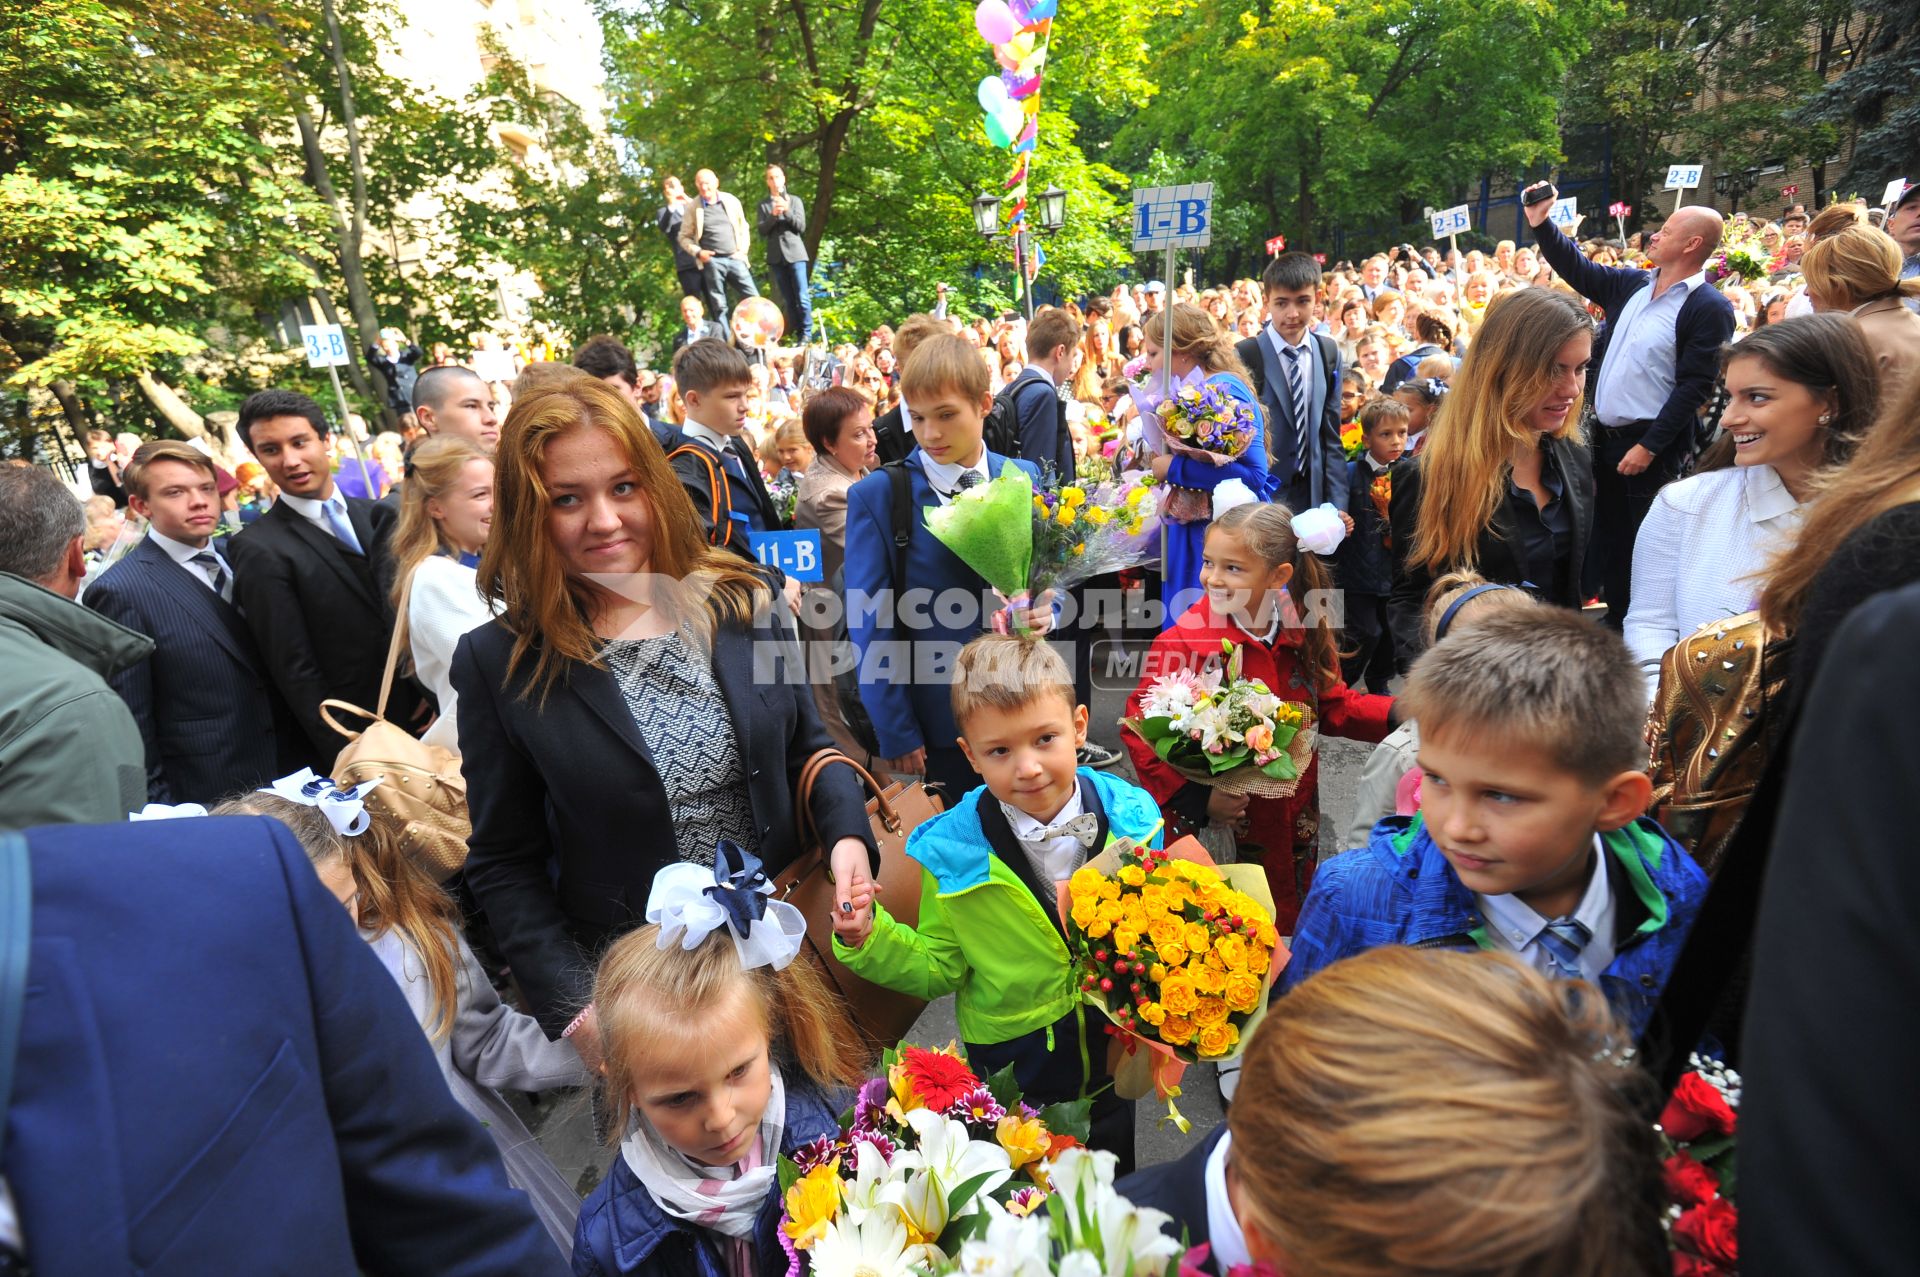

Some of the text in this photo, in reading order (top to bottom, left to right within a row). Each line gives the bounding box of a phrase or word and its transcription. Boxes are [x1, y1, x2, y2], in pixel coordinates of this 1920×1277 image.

[1669, 170, 1698, 183] 2-В
[1137, 199, 1207, 238] 1-В
[1434, 212, 1466, 232] 2-Б
[1551, 205, 1573, 222] -А
[306, 334, 344, 358] 3-В
[756, 540, 816, 572] 11-В
